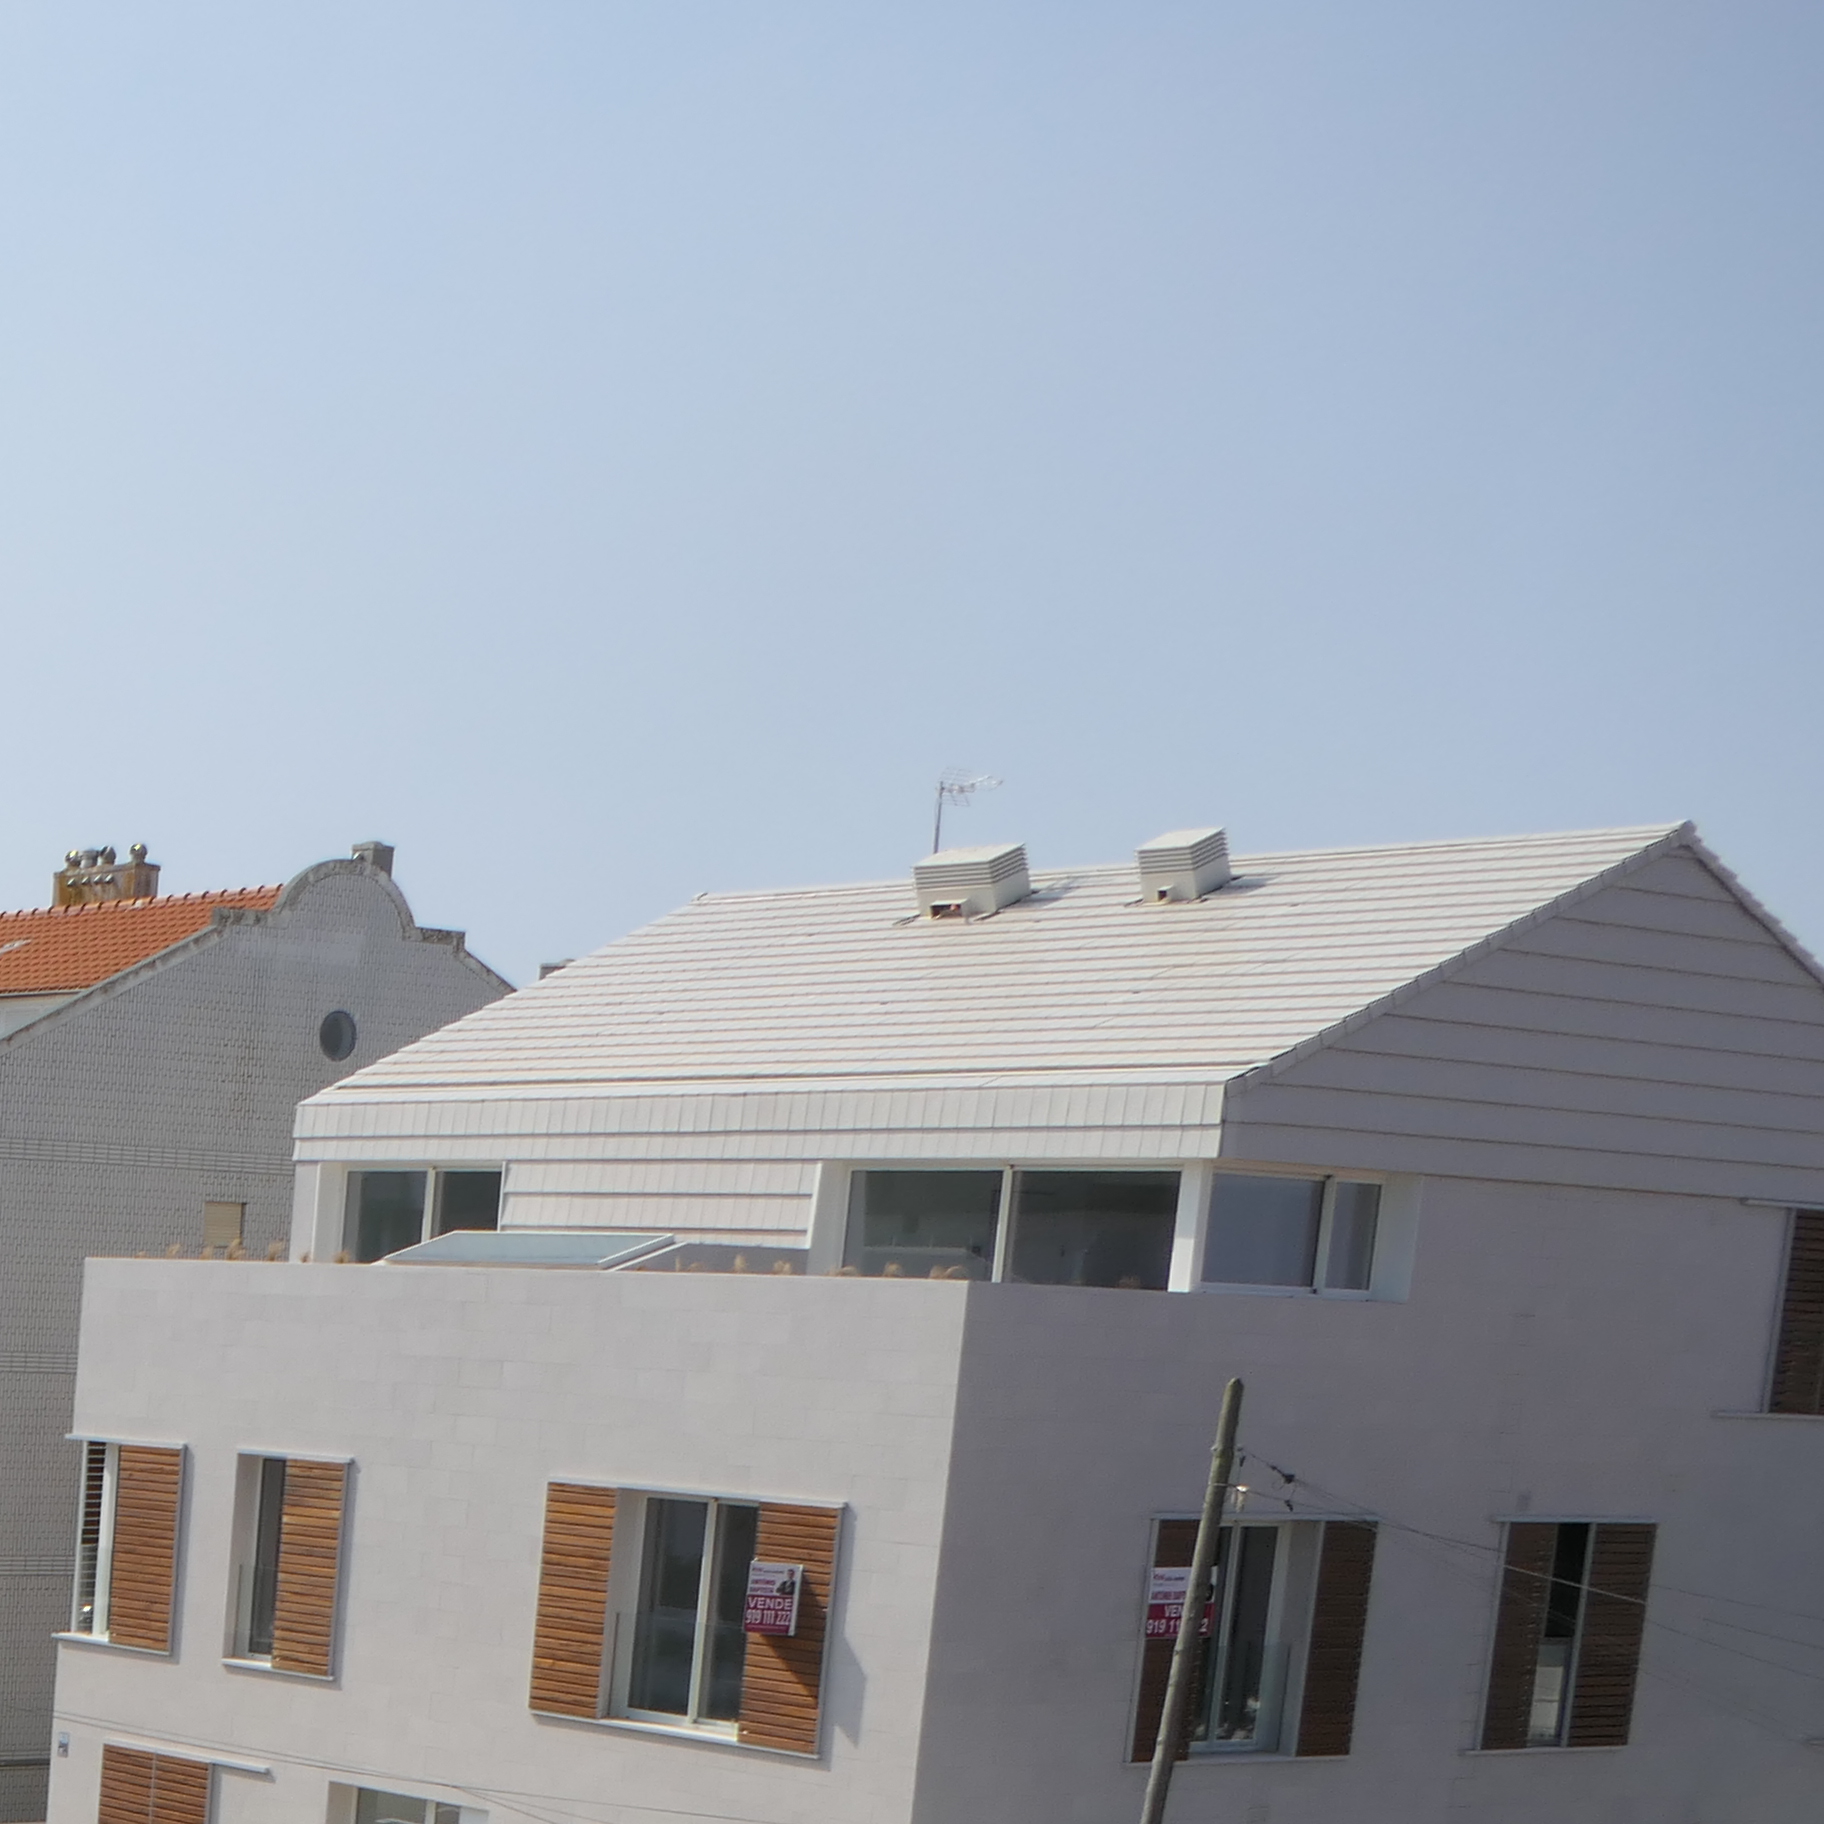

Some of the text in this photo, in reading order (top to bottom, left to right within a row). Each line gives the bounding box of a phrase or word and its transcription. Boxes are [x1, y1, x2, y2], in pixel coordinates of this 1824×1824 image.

[748, 1597, 793, 1609] VENDE
[745, 1608, 790, 1625] 919 111 222
[1164, 1605, 1183, 1617] VEN
[1146, 1619, 1181, 1634] 919 11
